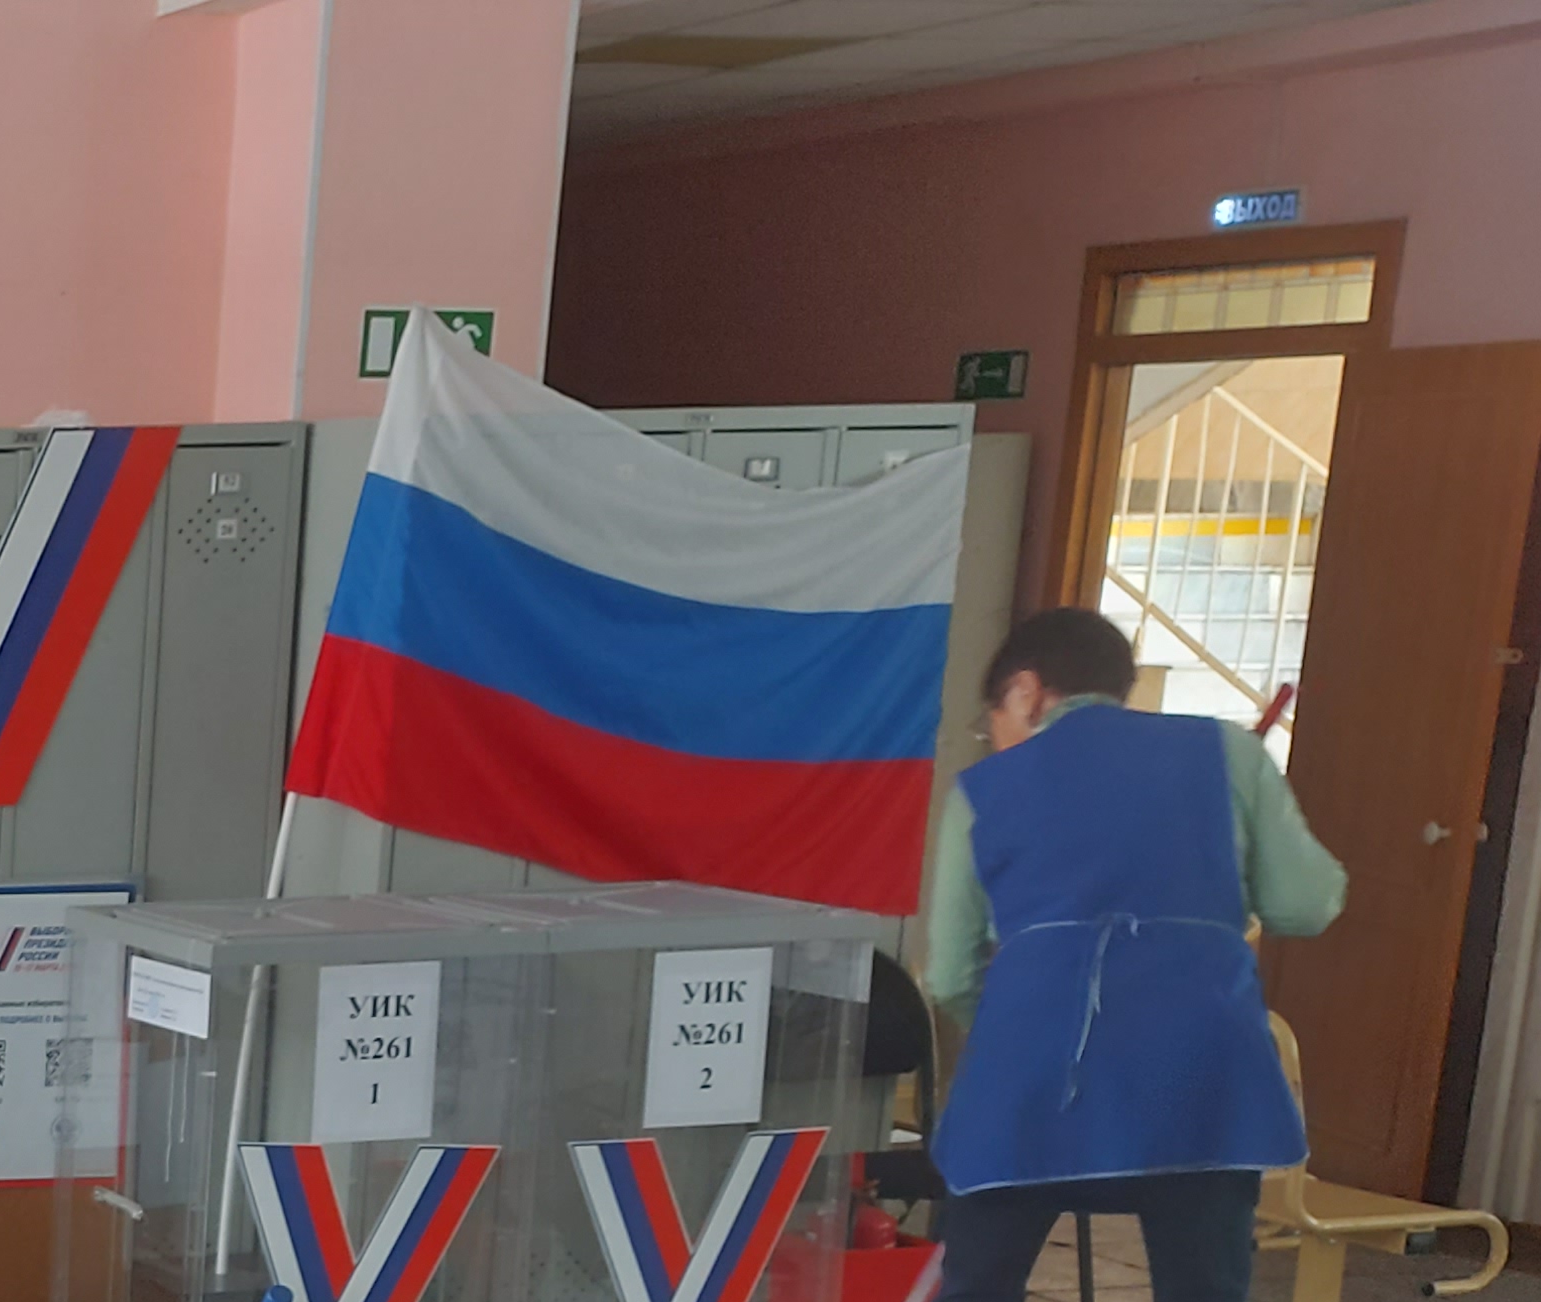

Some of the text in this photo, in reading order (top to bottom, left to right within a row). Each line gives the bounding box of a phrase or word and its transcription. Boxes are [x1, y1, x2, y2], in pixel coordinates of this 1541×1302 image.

[682, 980, 748, 1005] УИК
[347, 994, 416, 1020] УИК
[671, 1022, 744, 1047] №261
[338, 1036, 413, 1061] №261
[699, 1067, 713, 1089] 2
[370, 1082, 379, 1105] 1
